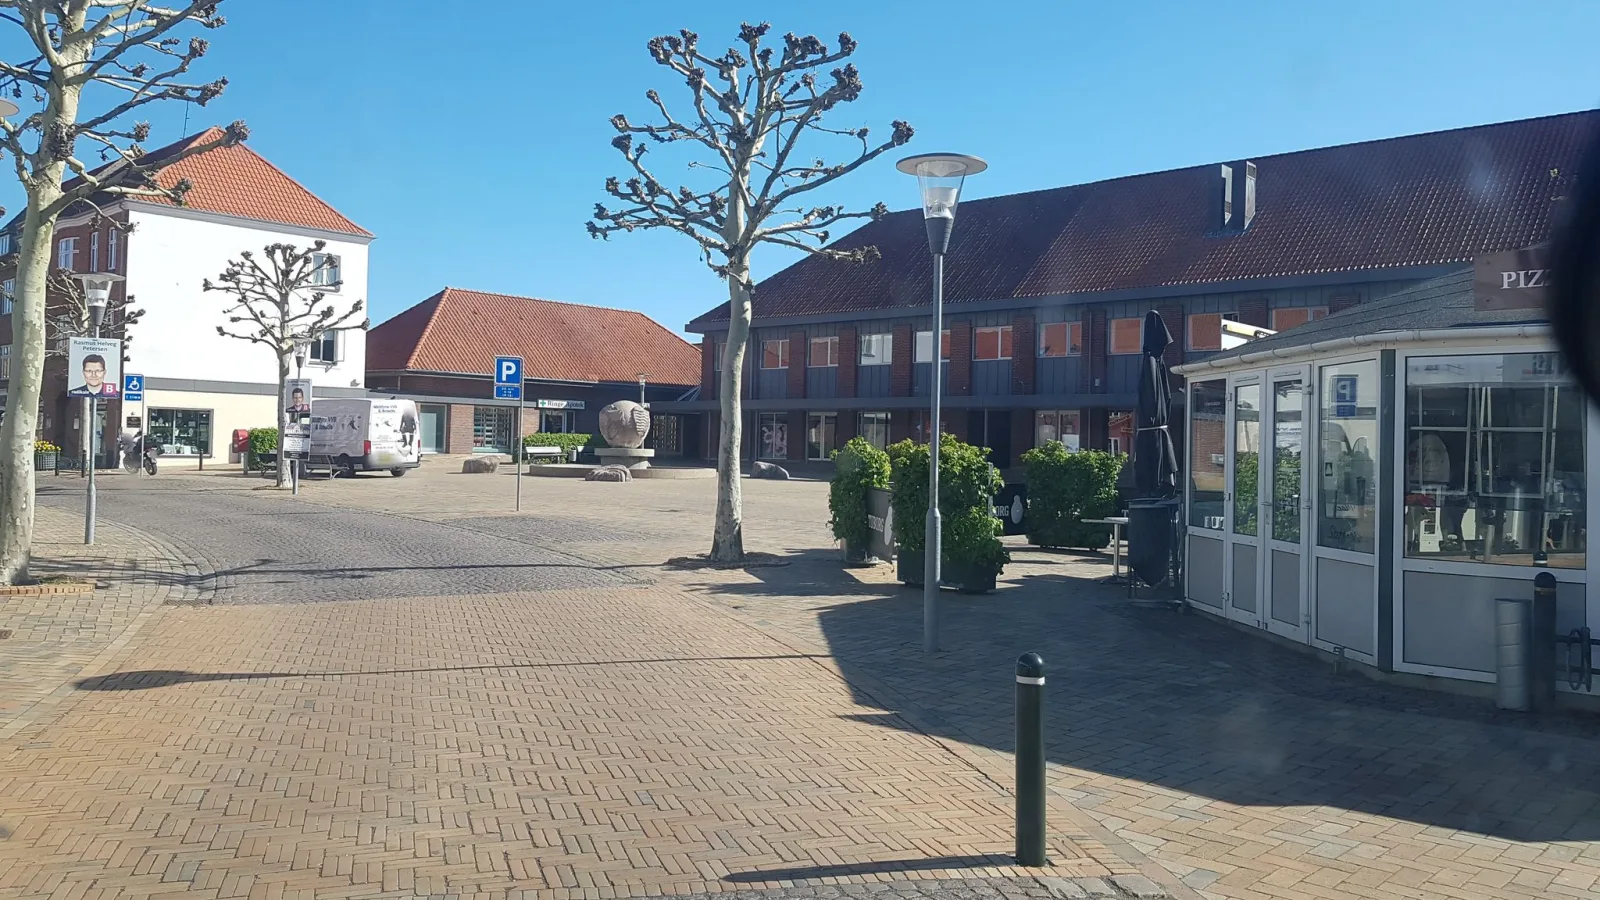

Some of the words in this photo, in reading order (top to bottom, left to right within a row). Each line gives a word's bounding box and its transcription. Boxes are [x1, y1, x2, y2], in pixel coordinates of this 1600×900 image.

[1500, 269, 1550, 289] PIZ
[502, 361, 516, 381] P
[105, 384, 113, 393] B
[868, 514, 884, 532] TUBORG
